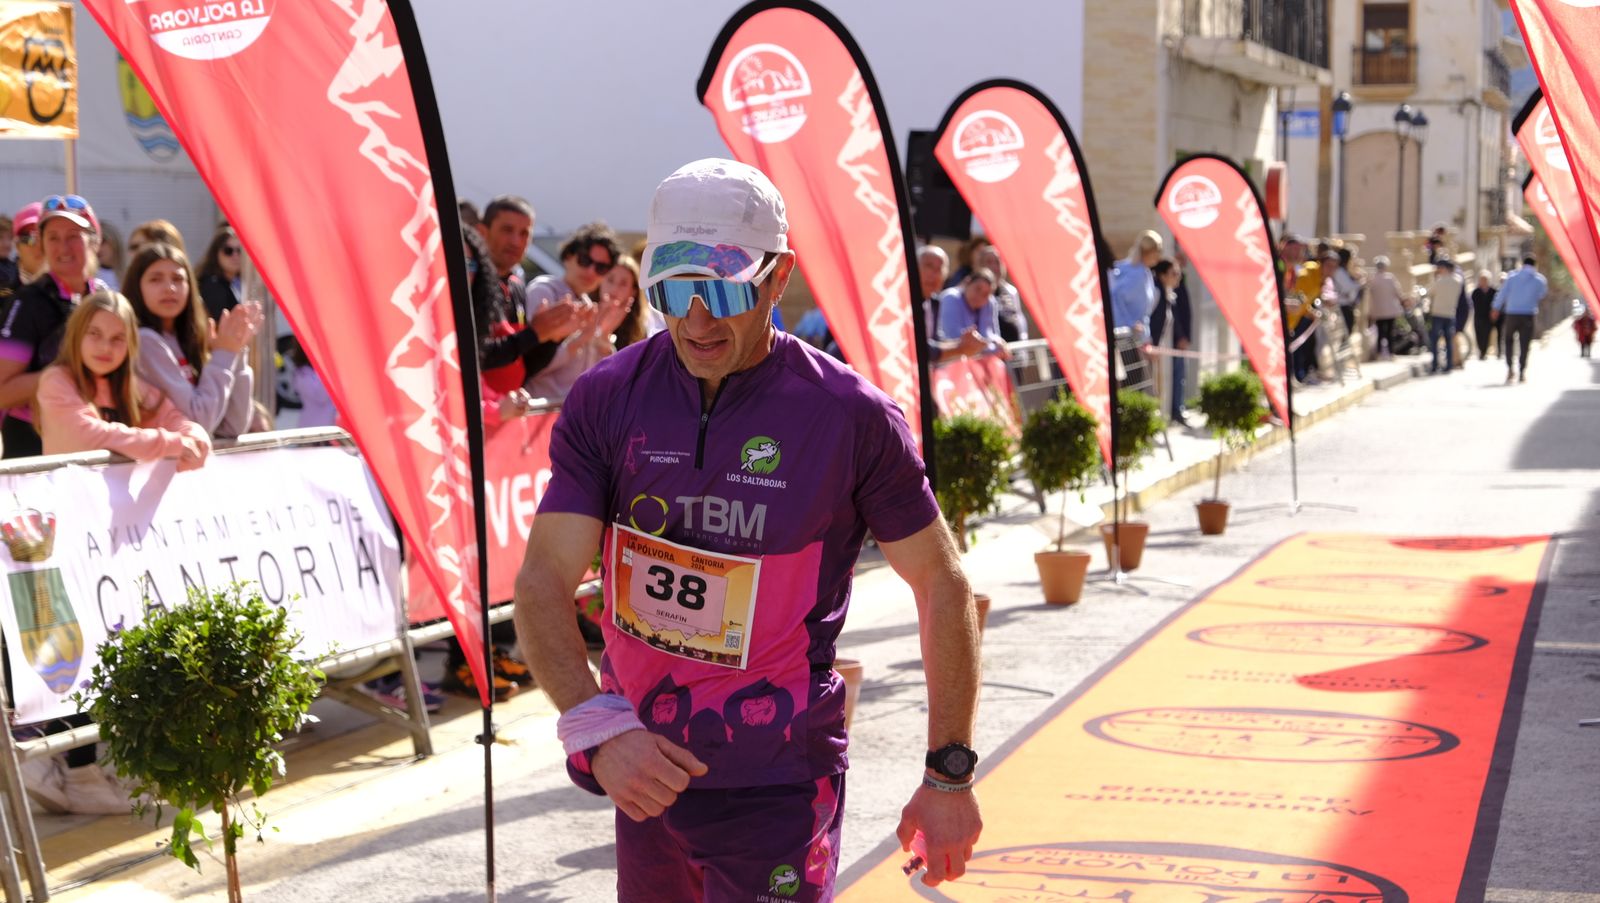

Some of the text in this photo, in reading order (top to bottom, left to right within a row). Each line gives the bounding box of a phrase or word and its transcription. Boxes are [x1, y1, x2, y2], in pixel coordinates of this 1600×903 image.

[726, 472, 787, 489] LOS SALTABOJAS
[86, 497, 364, 560] AYUNTAMIENTO DE
[675, 495, 768, 541] TBM
[626, 539, 637, 550] LA
[691, 555, 725, 569] CANTORIA
[96, 536, 381, 642] CANTORIA
[645, 564, 707, 611] 38
[1281, 871, 1350, 884] LA
